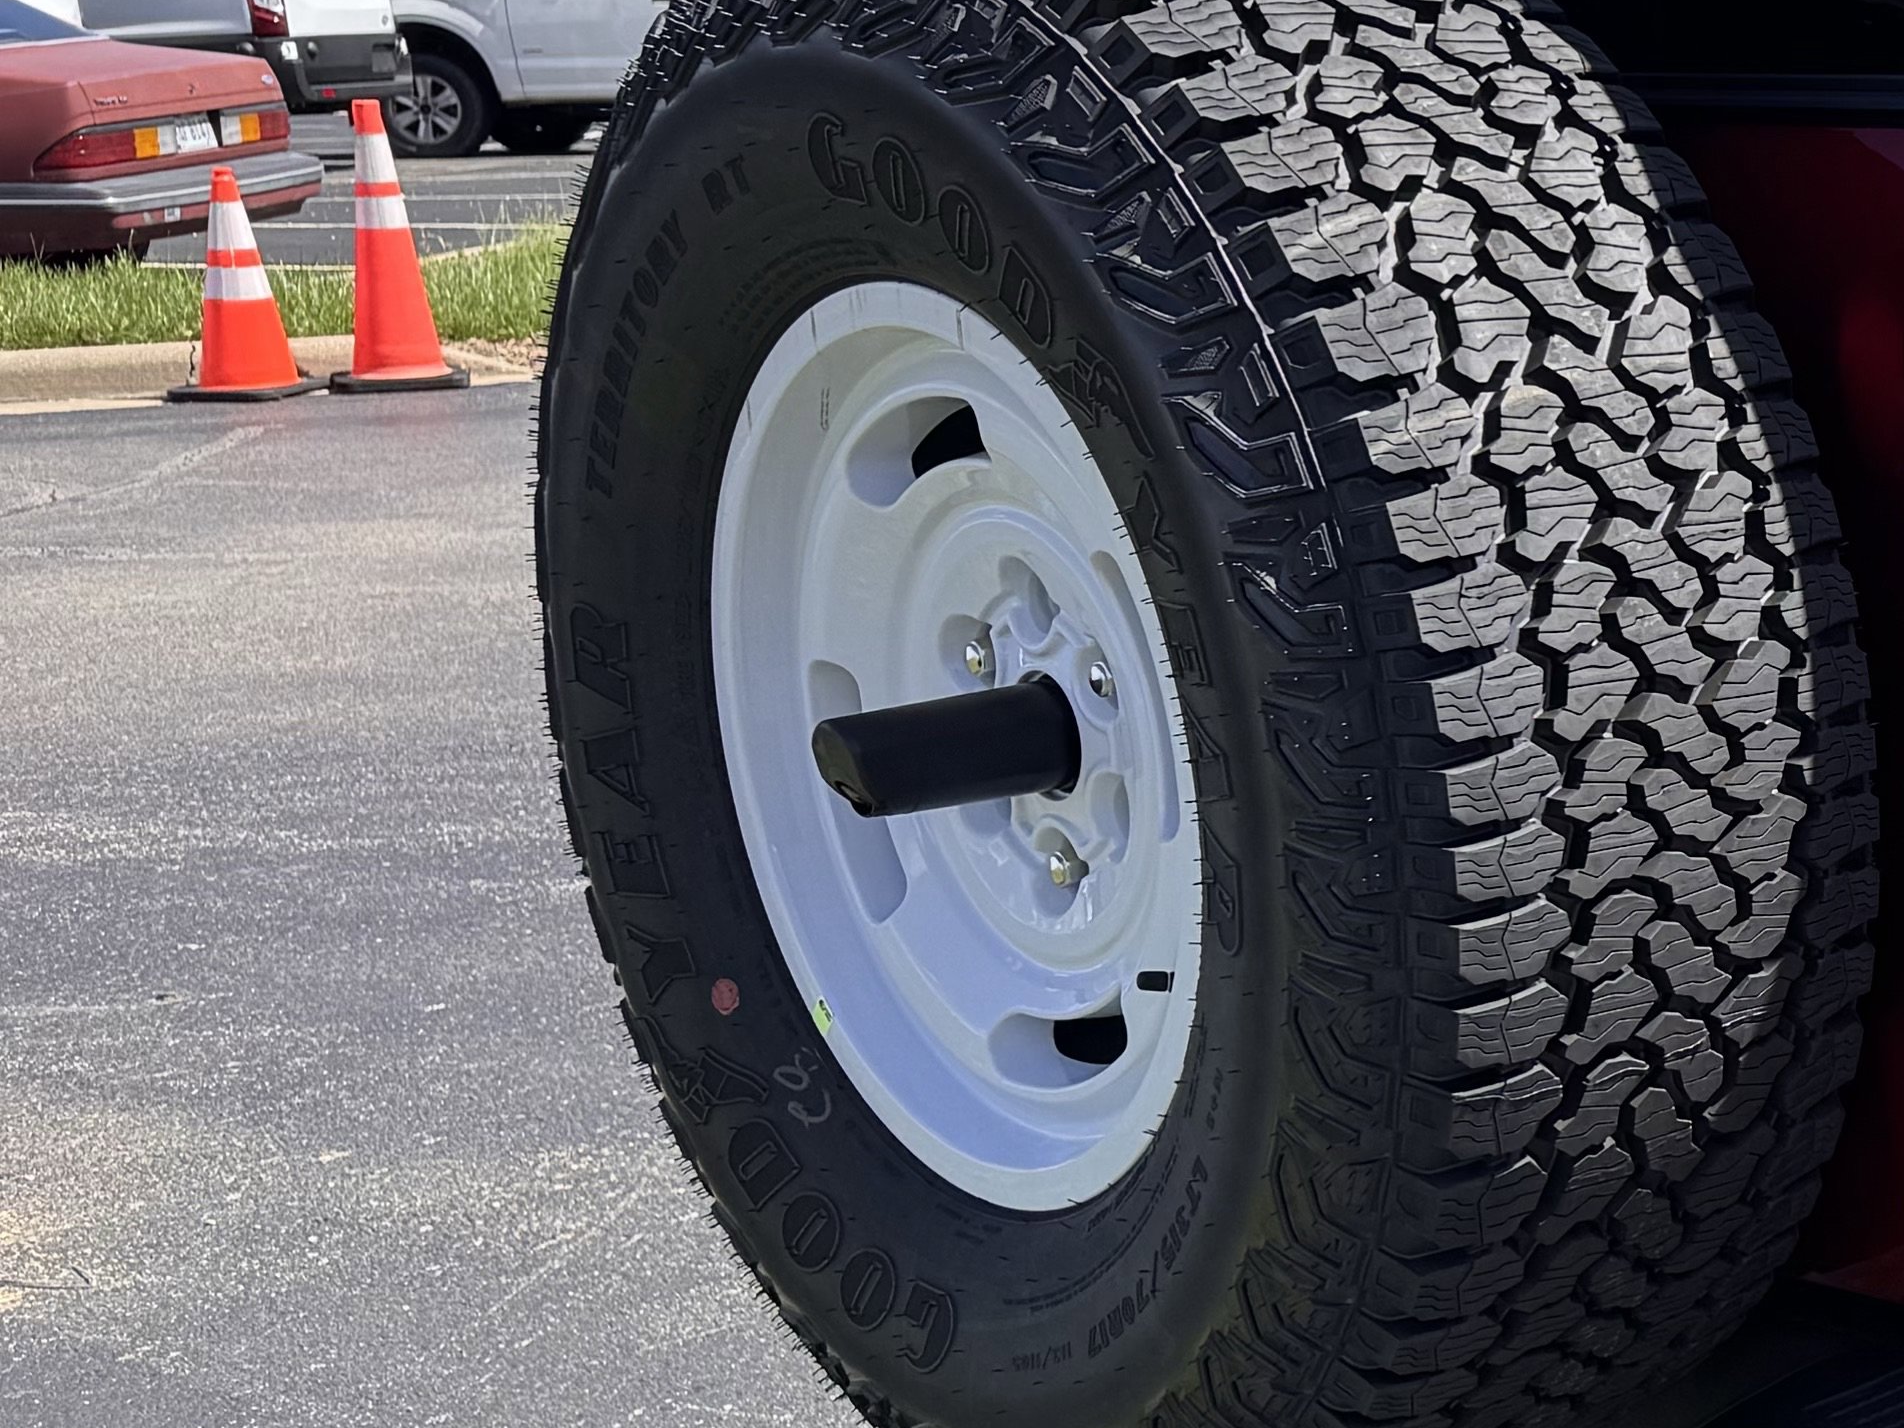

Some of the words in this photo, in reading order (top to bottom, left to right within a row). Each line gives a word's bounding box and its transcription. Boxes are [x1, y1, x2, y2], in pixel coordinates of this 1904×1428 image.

[584, 208, 690, 499] TERRITORY
[702, 153, 752, 215] RT
[570, 601, 958, 1374] GOODYEAR
